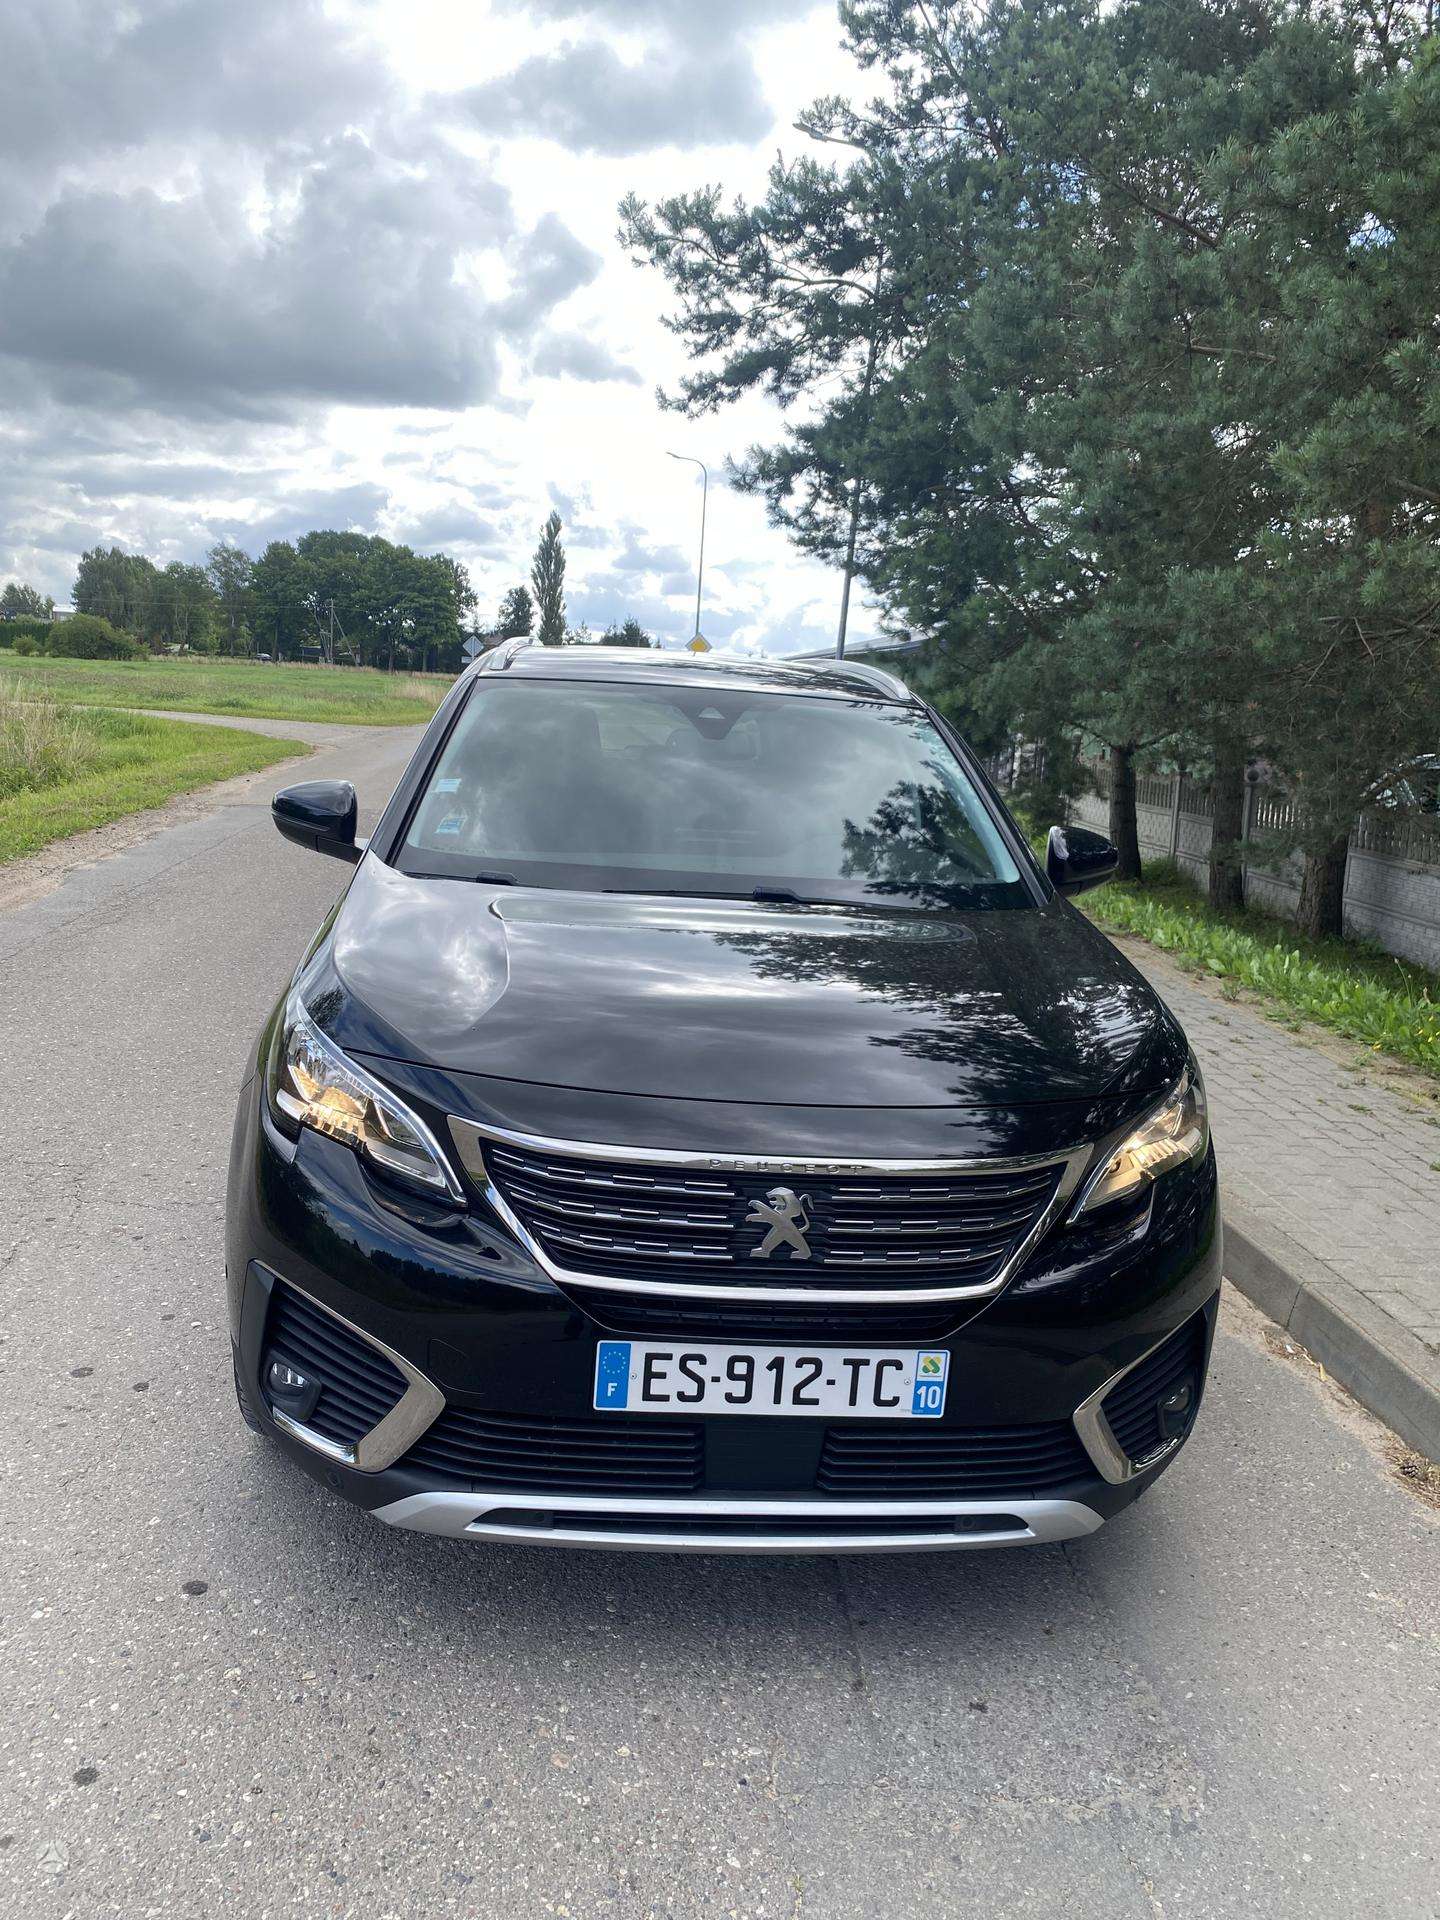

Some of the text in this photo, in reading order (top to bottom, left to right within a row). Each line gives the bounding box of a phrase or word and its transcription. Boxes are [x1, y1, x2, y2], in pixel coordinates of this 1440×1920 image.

[709, 1158, 864, 1175] PEUGEOT
[607, 1382, 618, 1397] F
[641, 1352, 904, 1408] ES-912-TC
[916, 1385, 941, 1409] 10
